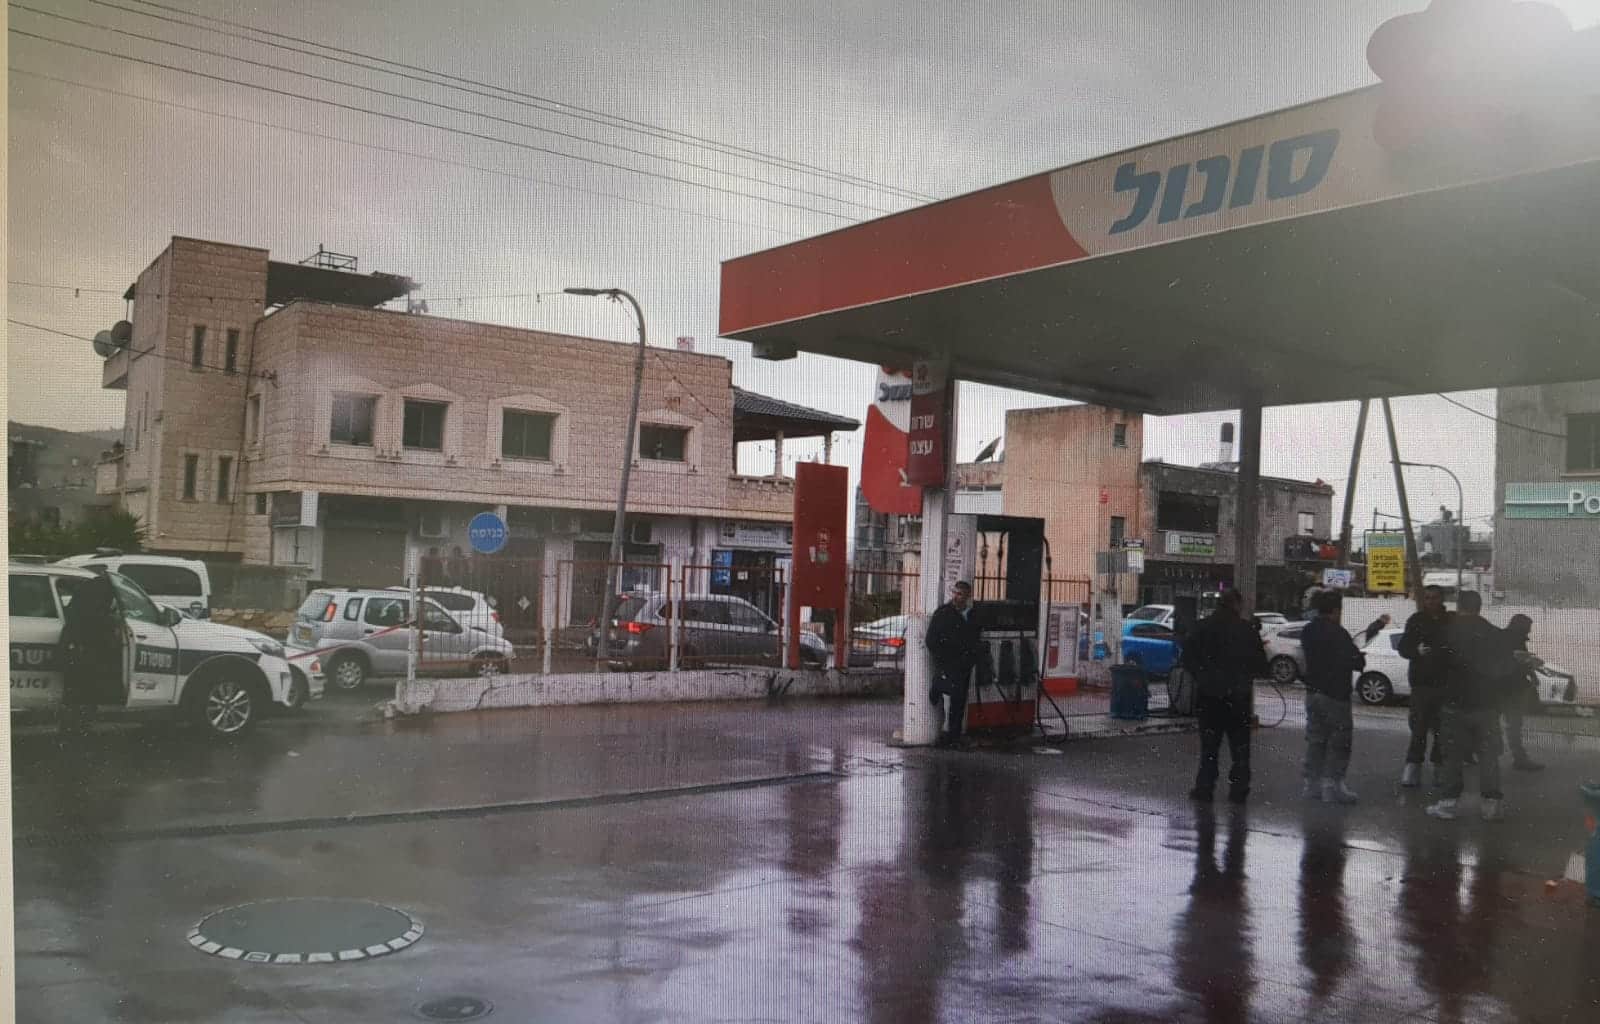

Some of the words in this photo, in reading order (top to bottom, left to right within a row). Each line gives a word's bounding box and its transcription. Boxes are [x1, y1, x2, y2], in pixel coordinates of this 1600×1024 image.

[1109, 128, 1340, 235] סונול
[470, 527, 503, 539] כניסה
[11, 647, 53, 666] ישר
[10, 676, 50, 689] OLICE
